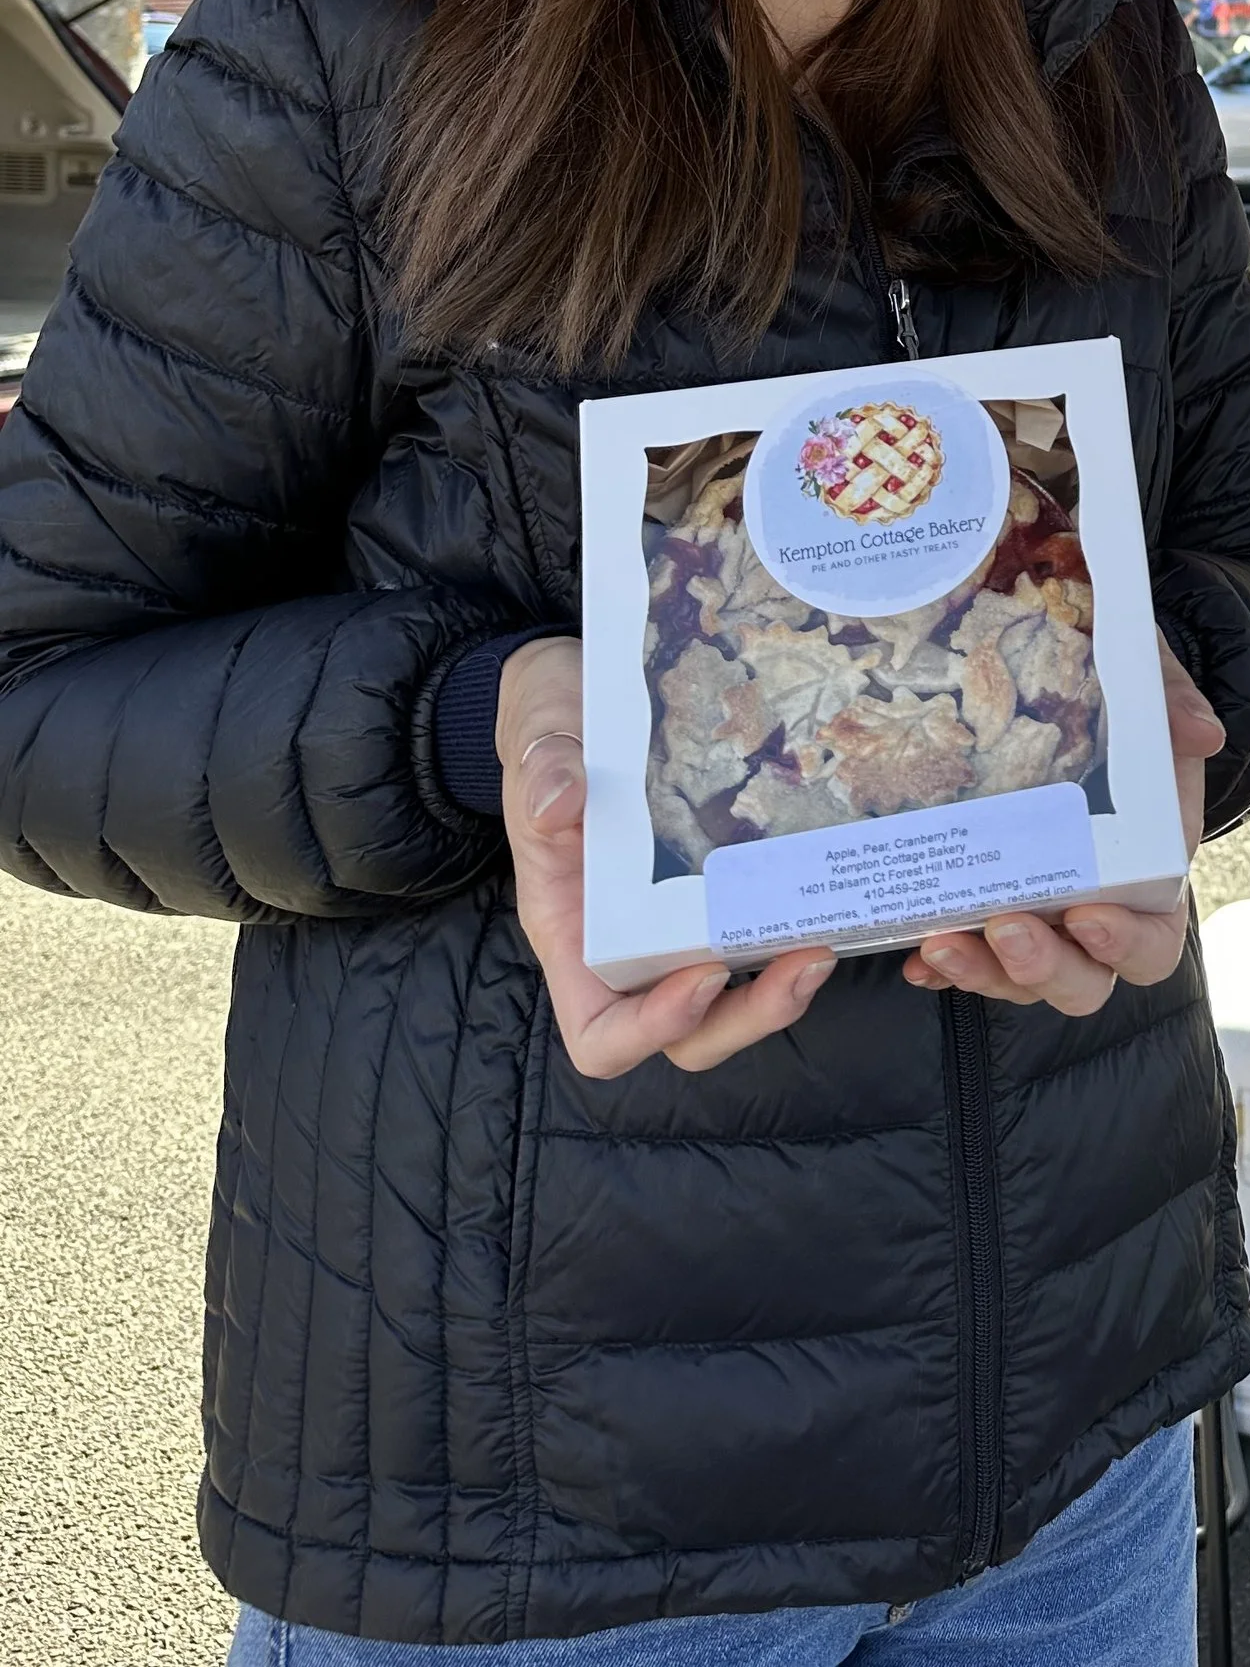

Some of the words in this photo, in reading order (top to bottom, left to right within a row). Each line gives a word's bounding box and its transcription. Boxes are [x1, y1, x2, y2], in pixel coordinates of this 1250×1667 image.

[779, 537, 856, 564] Kempton
[860, 525, 925, 550] Cottage
[928, 516, 987, 539] Bakery
[811, 562, 828, 574] PIE
[830, 558, 852, 571] AND
[854, 552, 888, 566] OTHER
[889, 547, 921, 560] TASTY
[922, 540, 960, 554] TREATS
[825, 848, 860, 863] Apple,
[894, 831, 948, 849] Cranberry
[950, 827, 969, 838] Pie
[831, 859, 880, 875] Kempton
[883, 851, 926, 866] Cottage
[928, 843, 966, 858] Bakery
[799, 882, 825, 897] 1401
[829, 876, 871, 892] Balsam
[872, 872, 886, 883] Ct
[888, 865, 923, 880] Forest
[925, 861, 943, 874] Hill
[945, 857, 965, 870] MD
[966, 850, 1001, 866] 21050
[720, 928, 755, 943] Apple,
[758, 921, 793, 936] pears,
[796, 909, 861, 929] cranberries,
[870, 901, 905, 915] lemon
[906, 895, 936, 911] juice,
[938, 888, 976, 903] cloves,
[1025, 868, 1081, 886] cinnamon,
[1007, 888, 1051, 903] reduced
